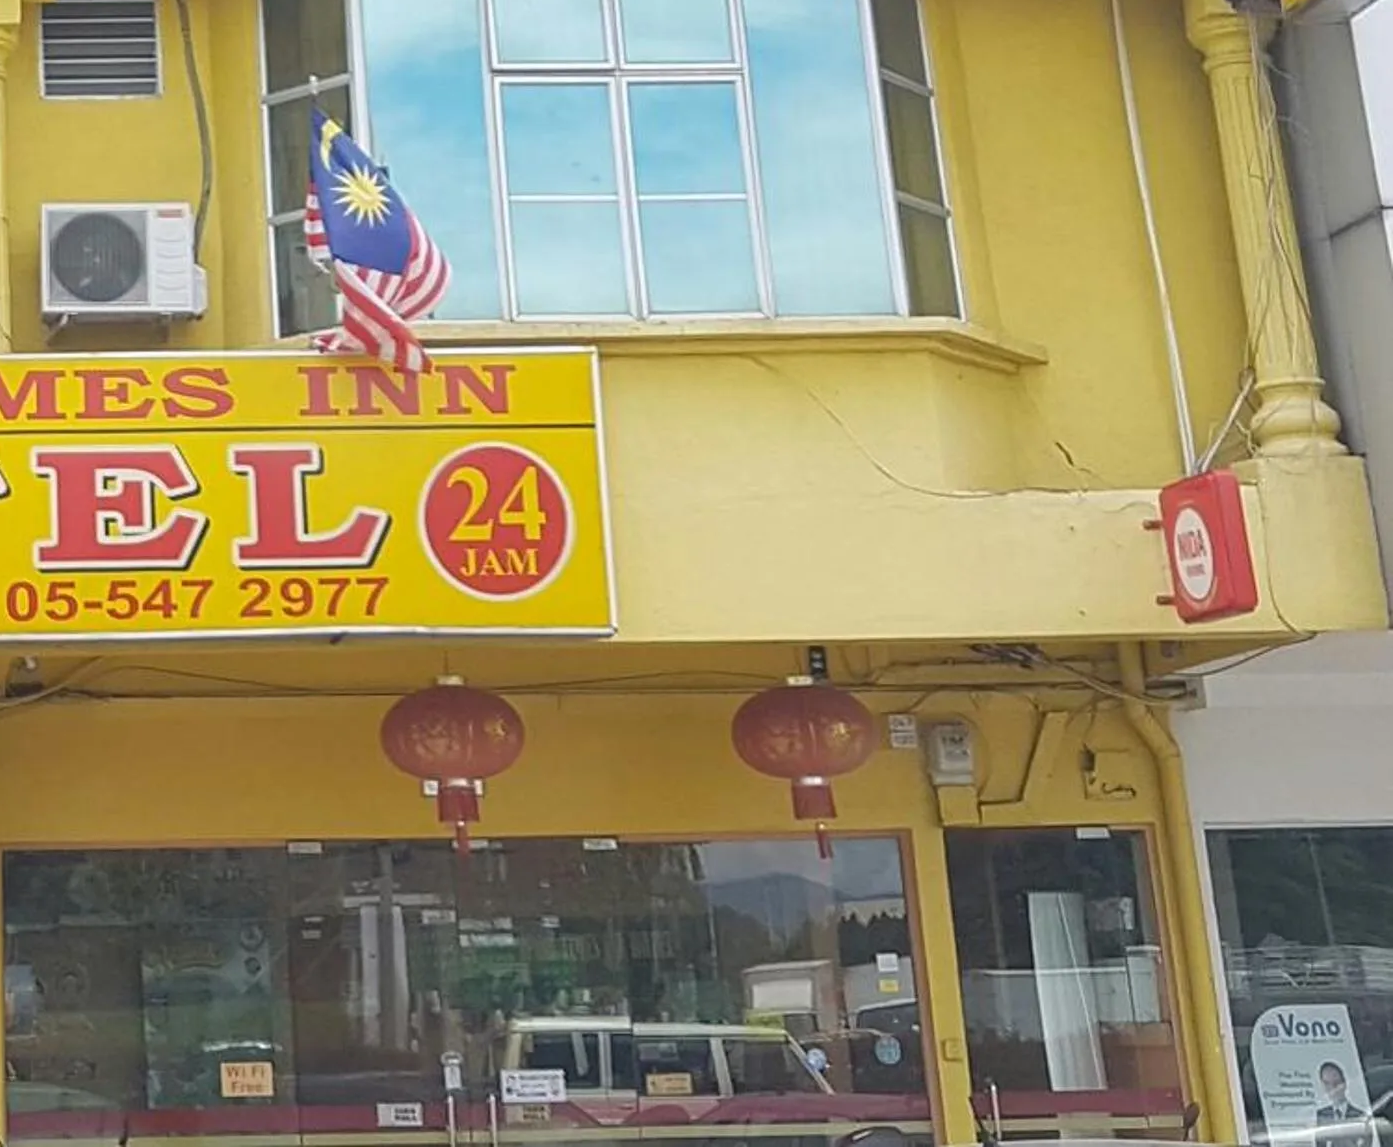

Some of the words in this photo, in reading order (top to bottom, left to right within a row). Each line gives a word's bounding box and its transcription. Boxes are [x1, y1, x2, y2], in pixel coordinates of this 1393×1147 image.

[298, 364, 516, 417] INN
[445, 465, 547, 543] 24
[459, 547, 540, 577] JAM
[6, 579, 215, 623] 05-547
[238, 577, 391, 620] 2977
[1277, 1013, 1341, 1038] Vono
